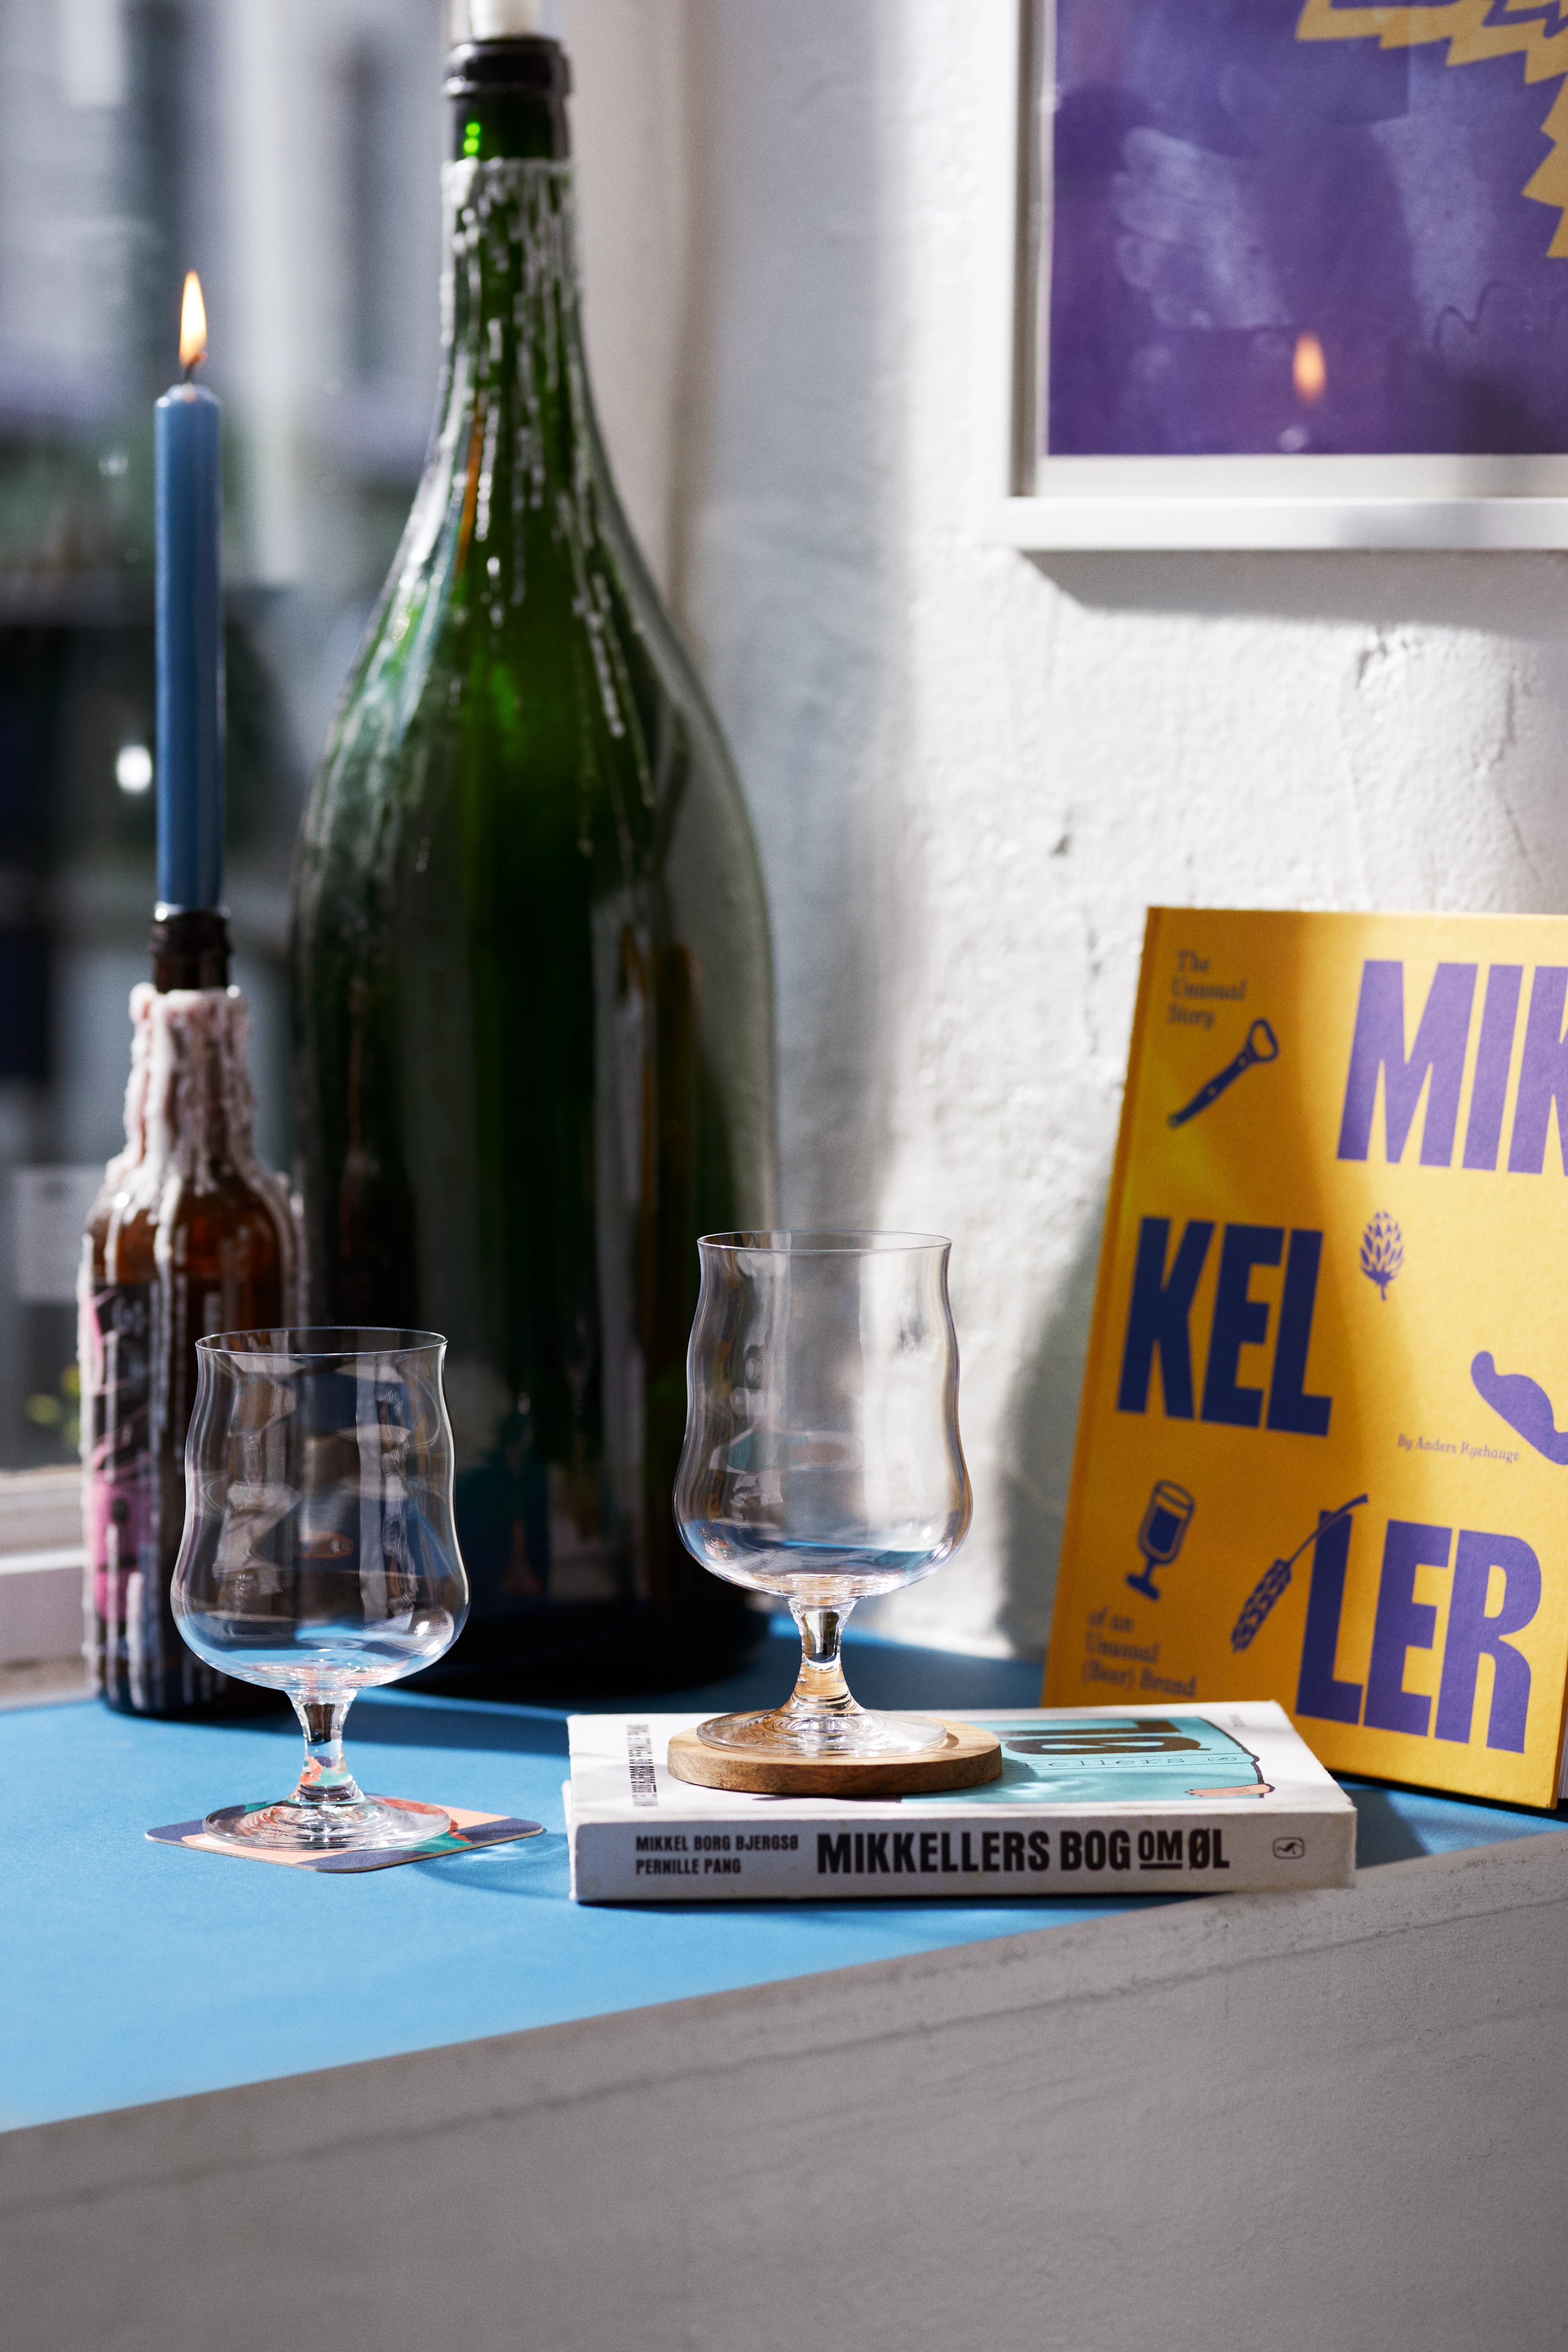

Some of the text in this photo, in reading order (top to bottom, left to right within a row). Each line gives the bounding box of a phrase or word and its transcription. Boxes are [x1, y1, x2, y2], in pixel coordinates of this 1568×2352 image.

[1336, 960, 1568, 1176] MIK
[1117, 1216, 1332, 1436] KEL
[1397, 1433, 1412, 1451] By
[1415, 1436, 1456, 1453] Anders
[1295, 1510, 1542, 1754] LER
[636, 1835, 688, 1852] MIKKEL
[694, 1835, 731, 1851] BORG
[636, 1858, 742, 1875] PERNILLE PANG
[817, 1828, 1230, 1874] MIKKELLERS BOG OM ØL
